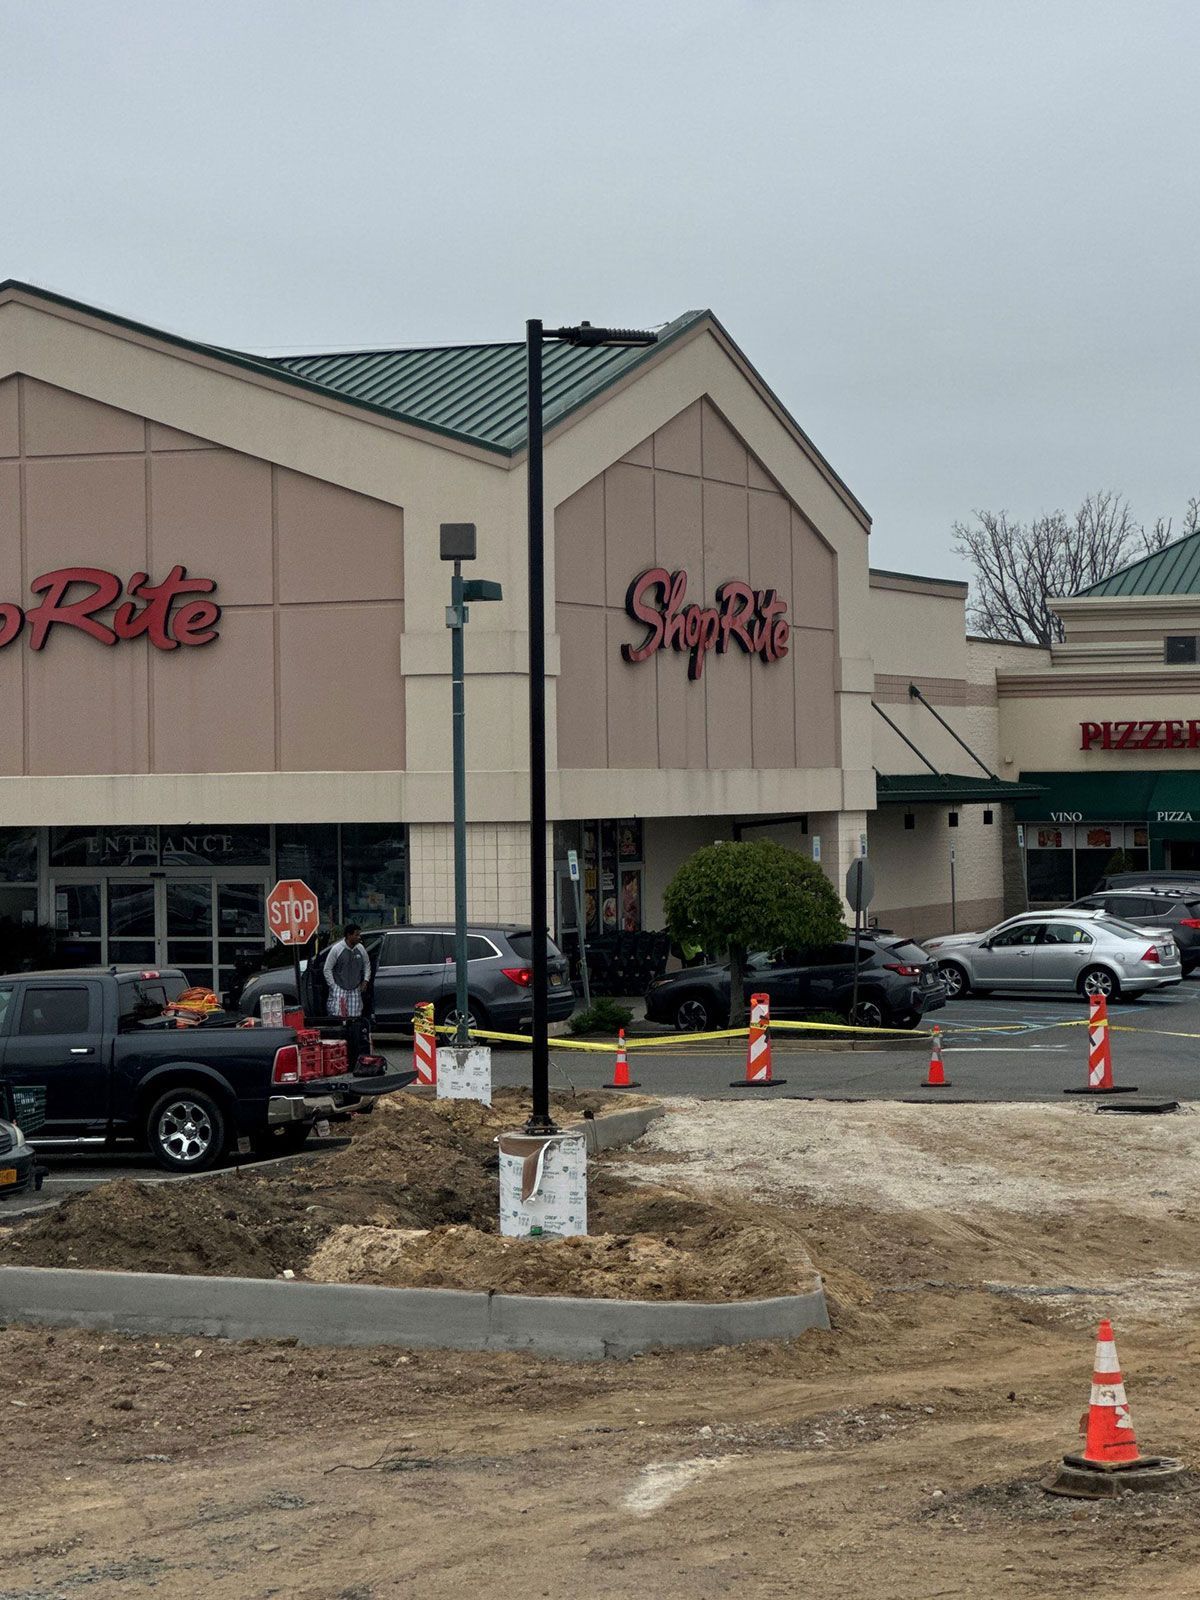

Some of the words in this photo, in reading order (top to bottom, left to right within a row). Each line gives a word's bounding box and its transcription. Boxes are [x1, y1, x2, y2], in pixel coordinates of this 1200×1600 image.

[620, 567, 790, 681] ShopRite
[1051, 811, 1083, 823] VINO
[1157, 811, 1193, 822] PIZZA
[86, 835, 235, 853] ENTRANCE
[270, 899, 315, 924] STOP
